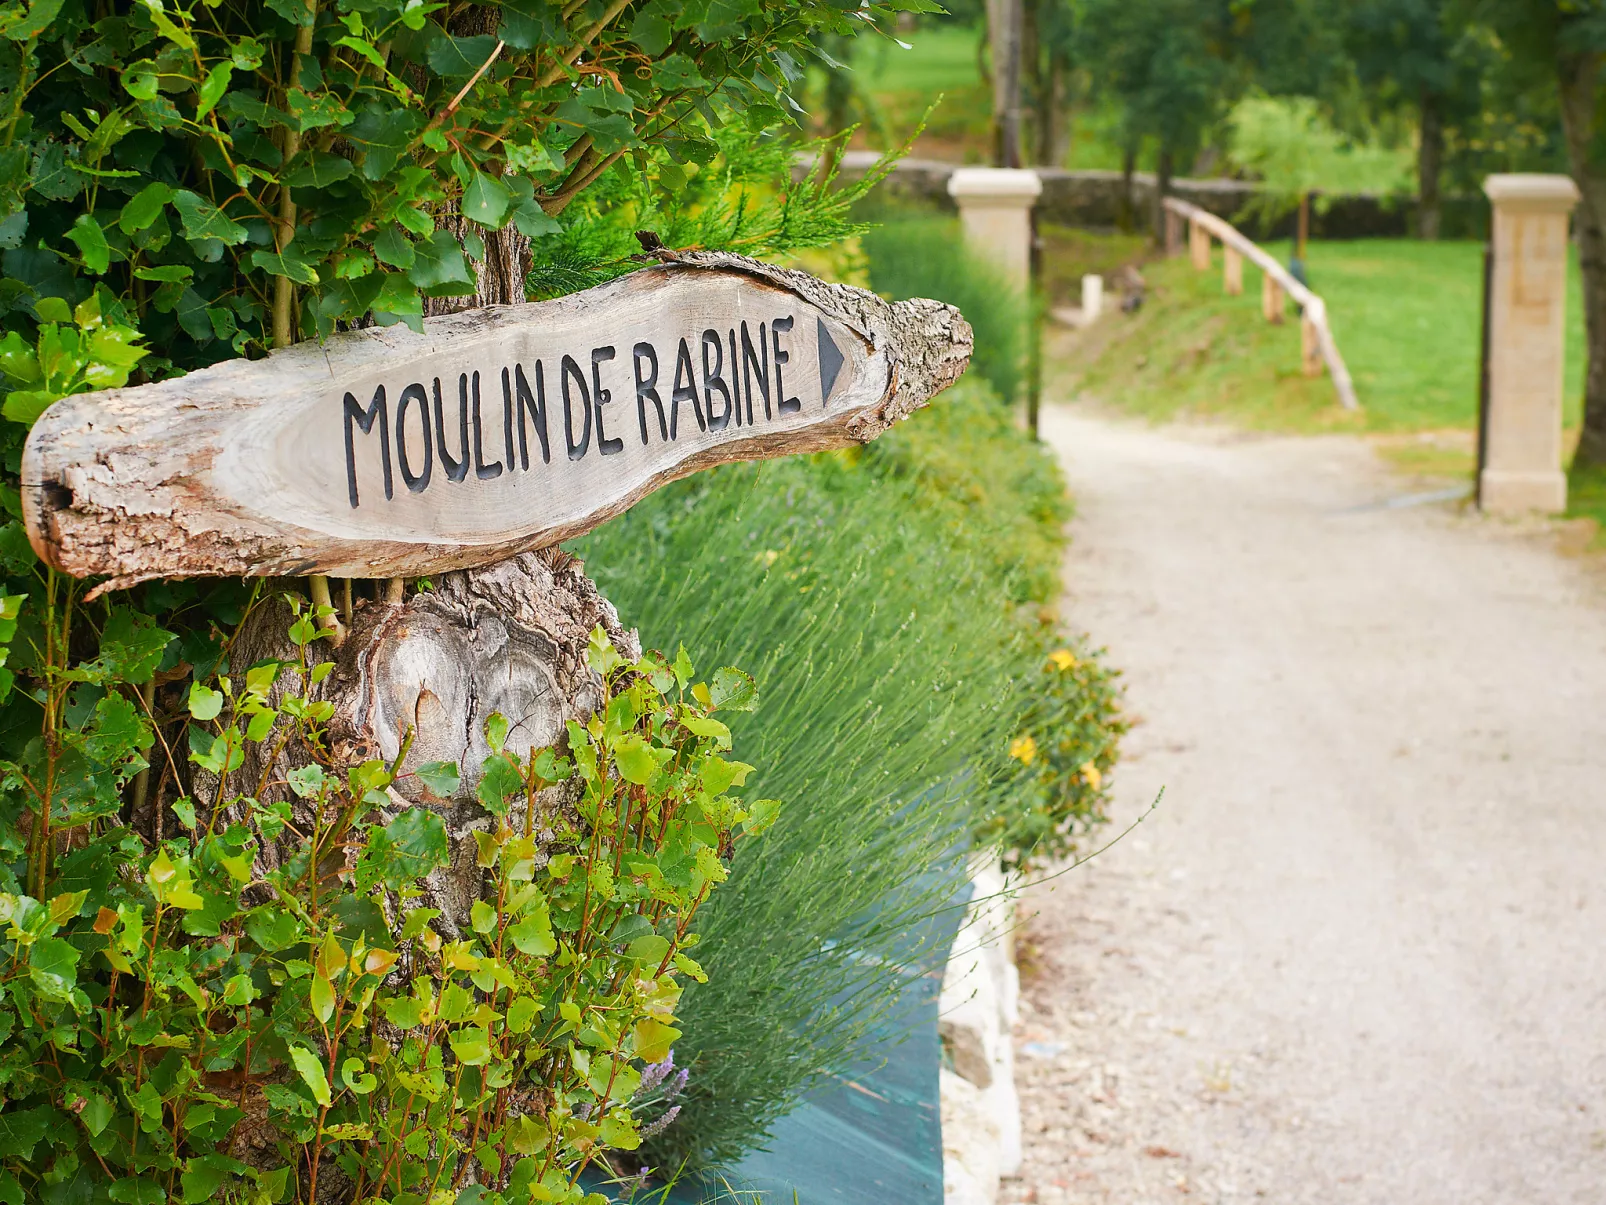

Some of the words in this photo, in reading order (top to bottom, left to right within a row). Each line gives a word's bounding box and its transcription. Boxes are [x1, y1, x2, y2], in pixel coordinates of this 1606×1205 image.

[343, 358, 550, 509] MOULIN
[561, 345, 624, 462] DE
[632, 315, 801, 445] RABINE
